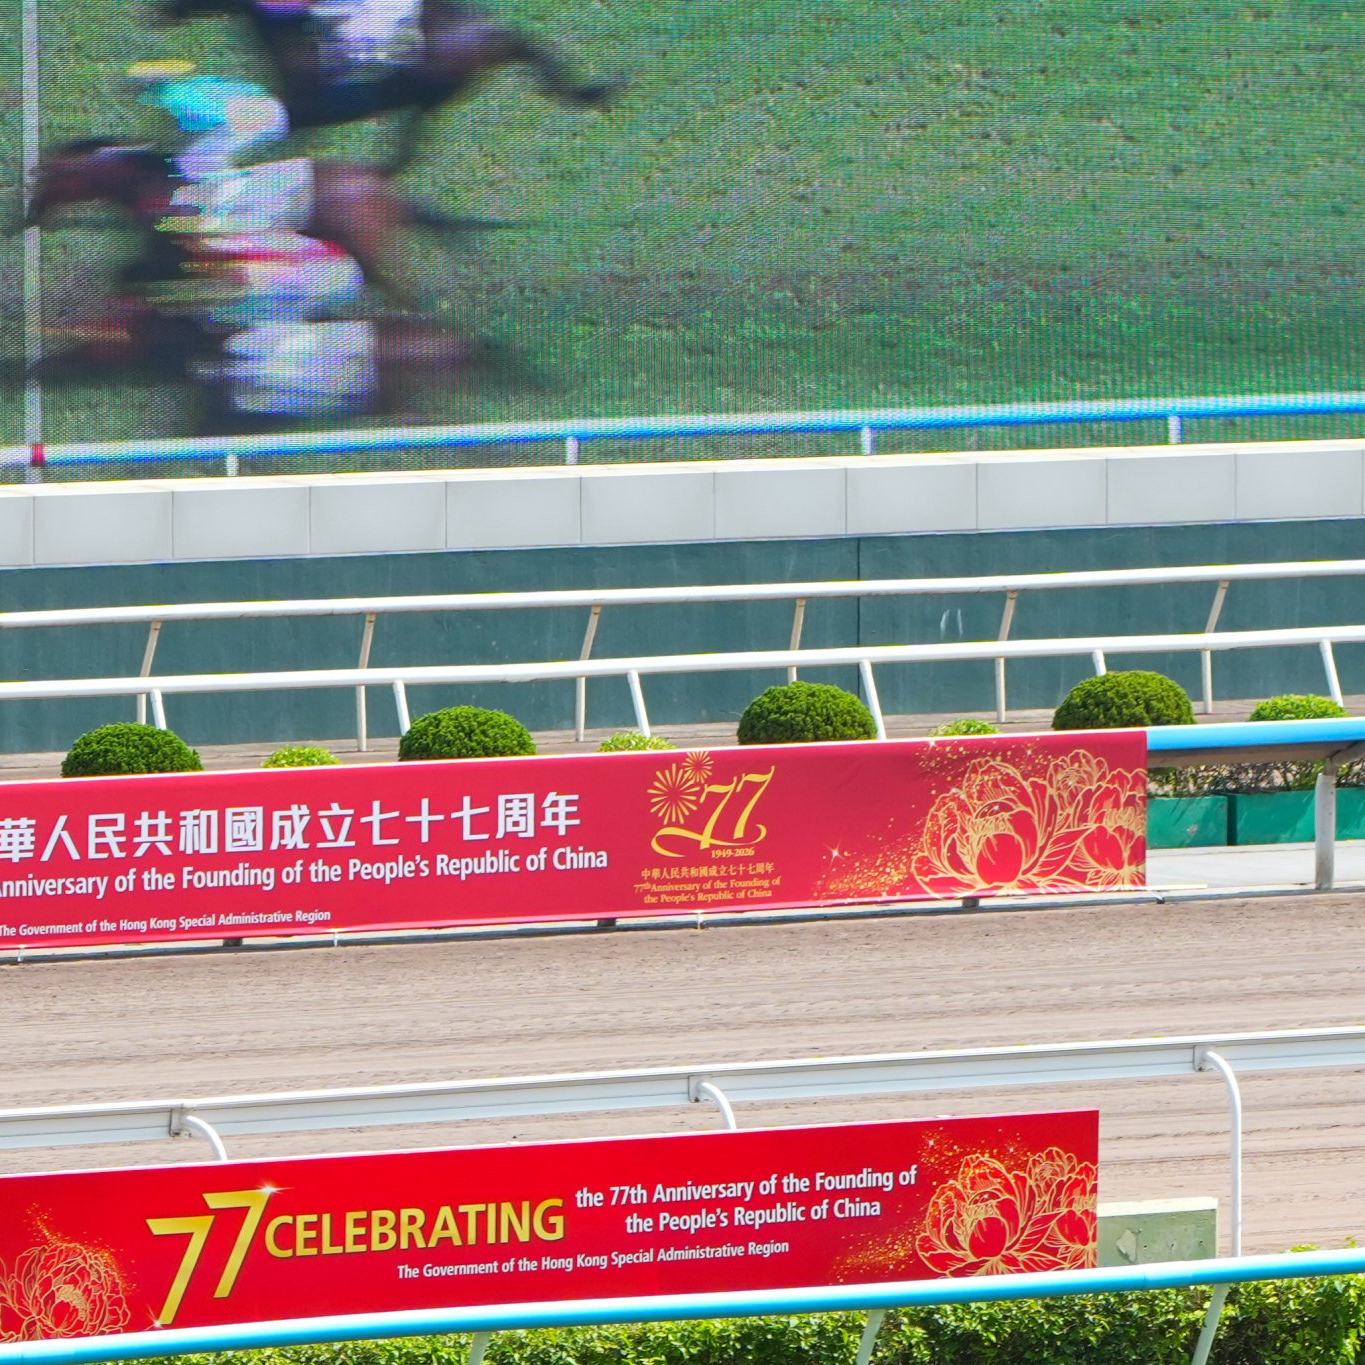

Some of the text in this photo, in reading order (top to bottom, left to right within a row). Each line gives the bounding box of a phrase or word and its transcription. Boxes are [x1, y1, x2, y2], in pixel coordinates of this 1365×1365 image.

[115, 868, 137, 893] of
[142, 867, 176, 891] the
[182, 862, 276, 891] Founding
[282, 860, 304, 884] of
[309, 859, 342, 883] the
[436, 849, 521, 881] Republic
[526, 847, 548, 872] of
[553, 846, 608, 871] China
[18, 922, 84, 936] Government
[85, 919, 98, 932] of
[99, 919, 118, 932] the
[119, 919, 148, 933] Hong
[149, 917, 177, 932] Kong
[178, 914, 216, 929] Special
[217, 911, 294, 926] Administrative
[295, 909, 331, 925] Region
[264, 1198, 565, 1258] CELEBRATING
[575, 1187, 604, 1208] the
[609, 1184, 648, 1206] 77th
[653, 1180, 755, 1209] Anniversary
[759, 1174, 779, 1195] of
[783, 1173, 811, 1194] the
[815, 1168, 894, 1197] Founding
[899, 1164, 918, 1186] of
[625, 1212, 654, 1234] the
[734, 1201, 806, 1230] Republic
[810, 1198, 830, 1220] of
[833, 1197, 881, 1218] China
[397, 1239, 790, 1279] The Government of the Hong Kong Special Administrative Region
